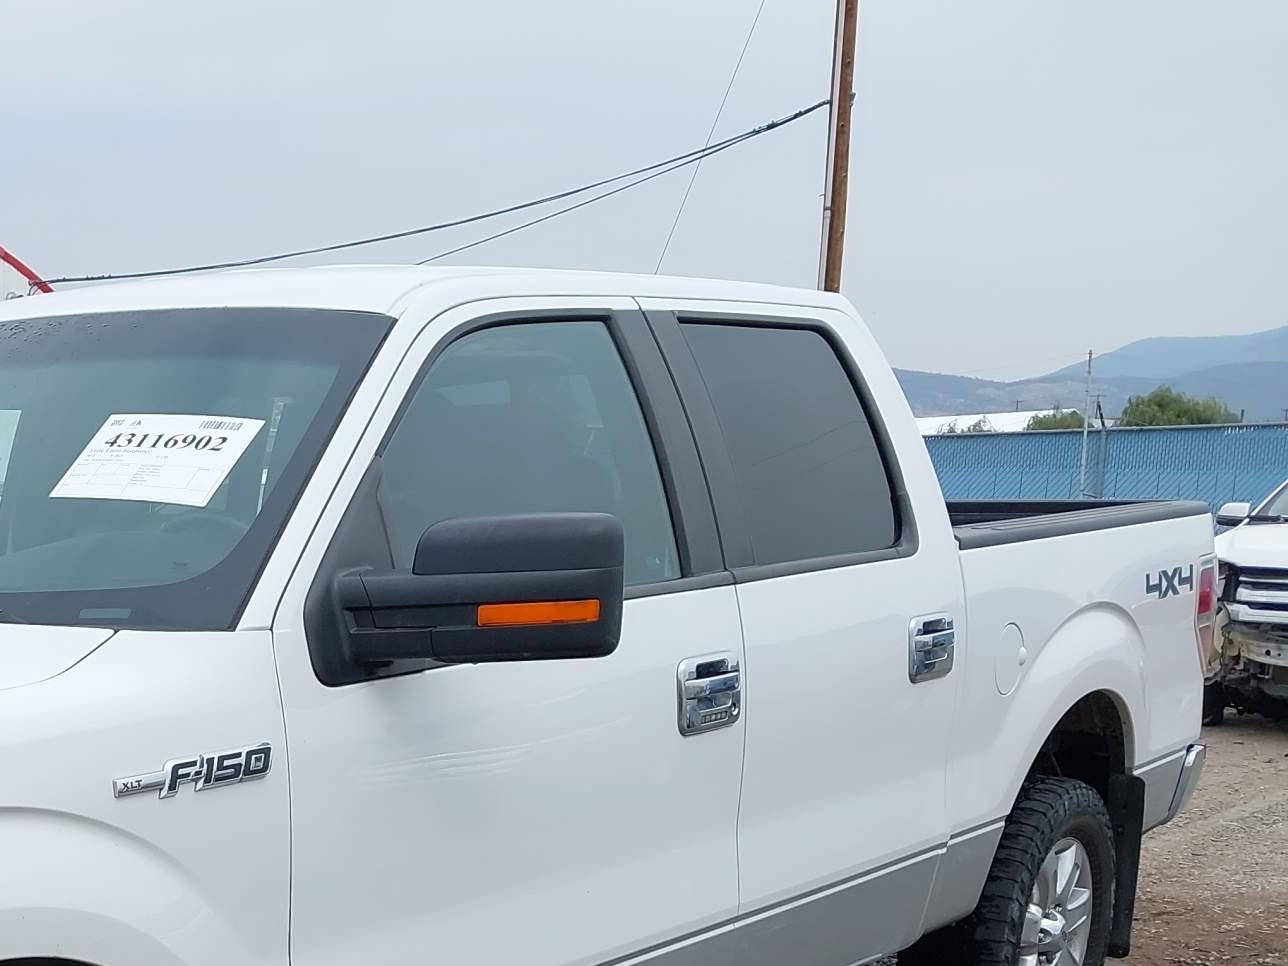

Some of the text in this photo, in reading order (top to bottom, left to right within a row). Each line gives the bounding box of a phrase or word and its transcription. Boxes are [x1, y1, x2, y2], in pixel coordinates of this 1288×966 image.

[105, 432, 228, 452] 43116902
[121, 744, 273, 797] XLT F-150
